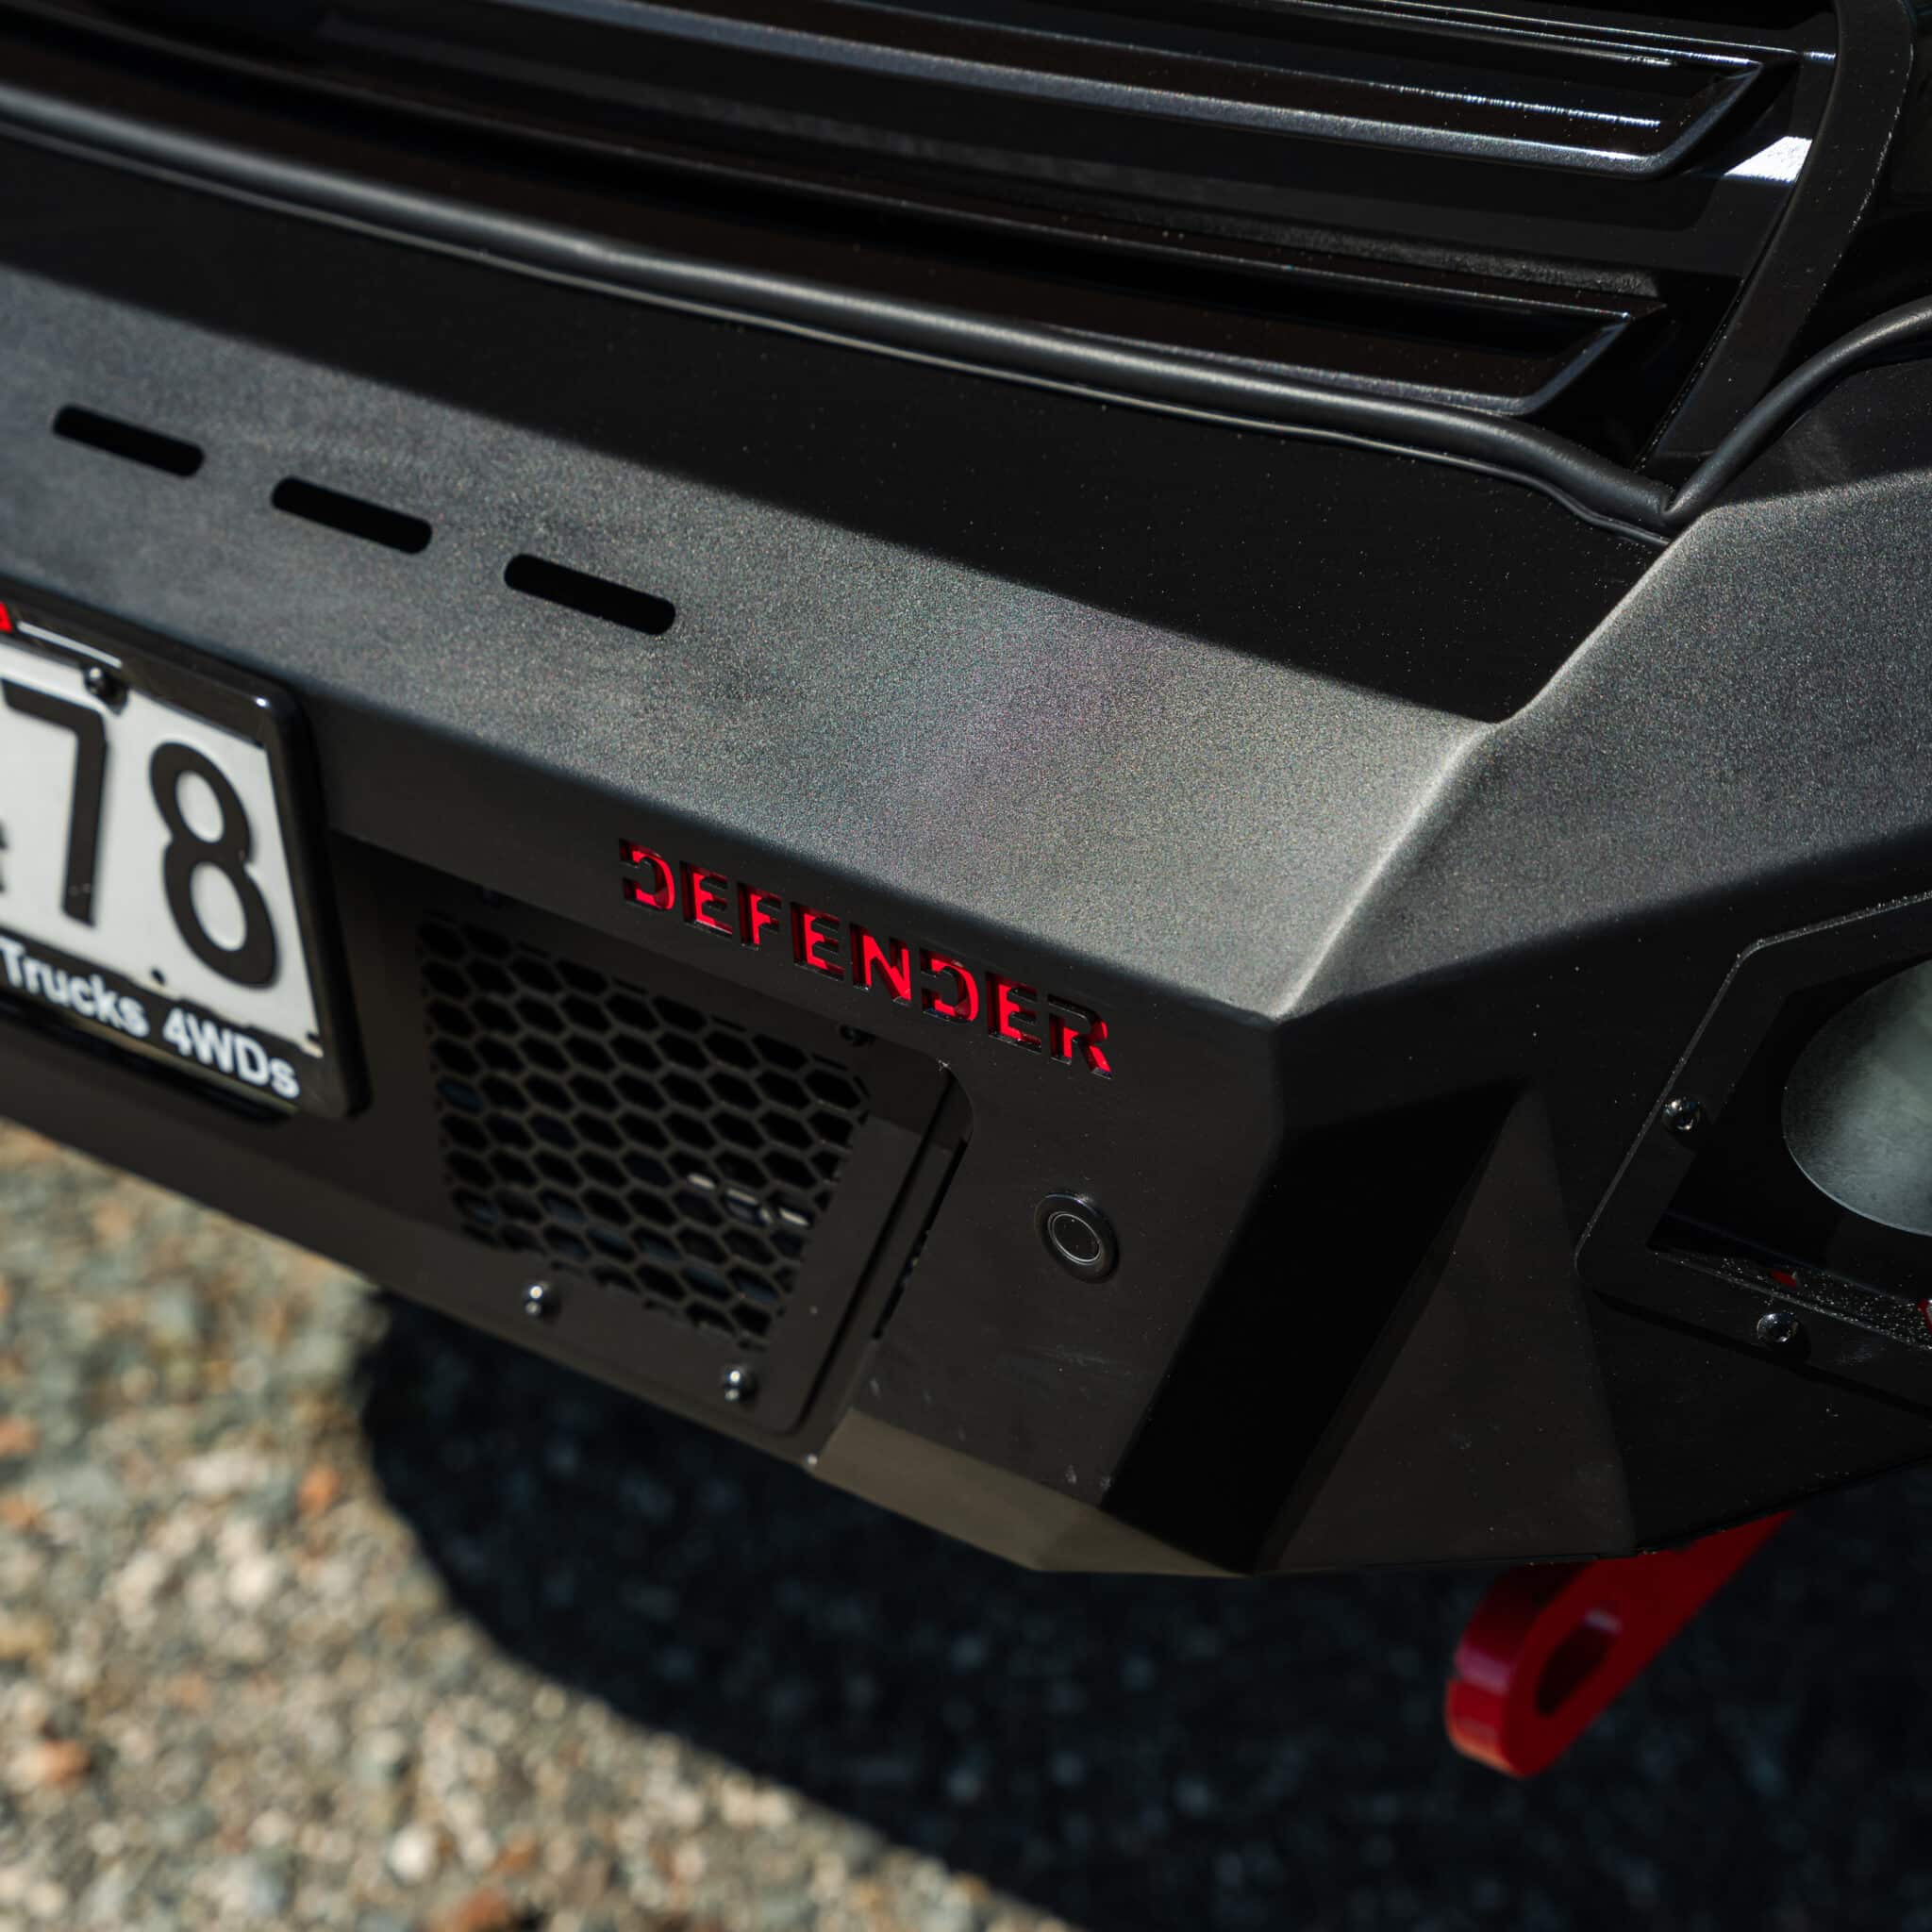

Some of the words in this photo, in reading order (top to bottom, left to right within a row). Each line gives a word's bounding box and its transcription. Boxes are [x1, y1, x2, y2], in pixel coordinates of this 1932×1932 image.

[0, 677, 279, 990] 78
[0, 938, 150, 1039] Trucks
[162, 1008, 301, 1099] 4WDs
[619, 839, 1114, 1079] DEFENDER
